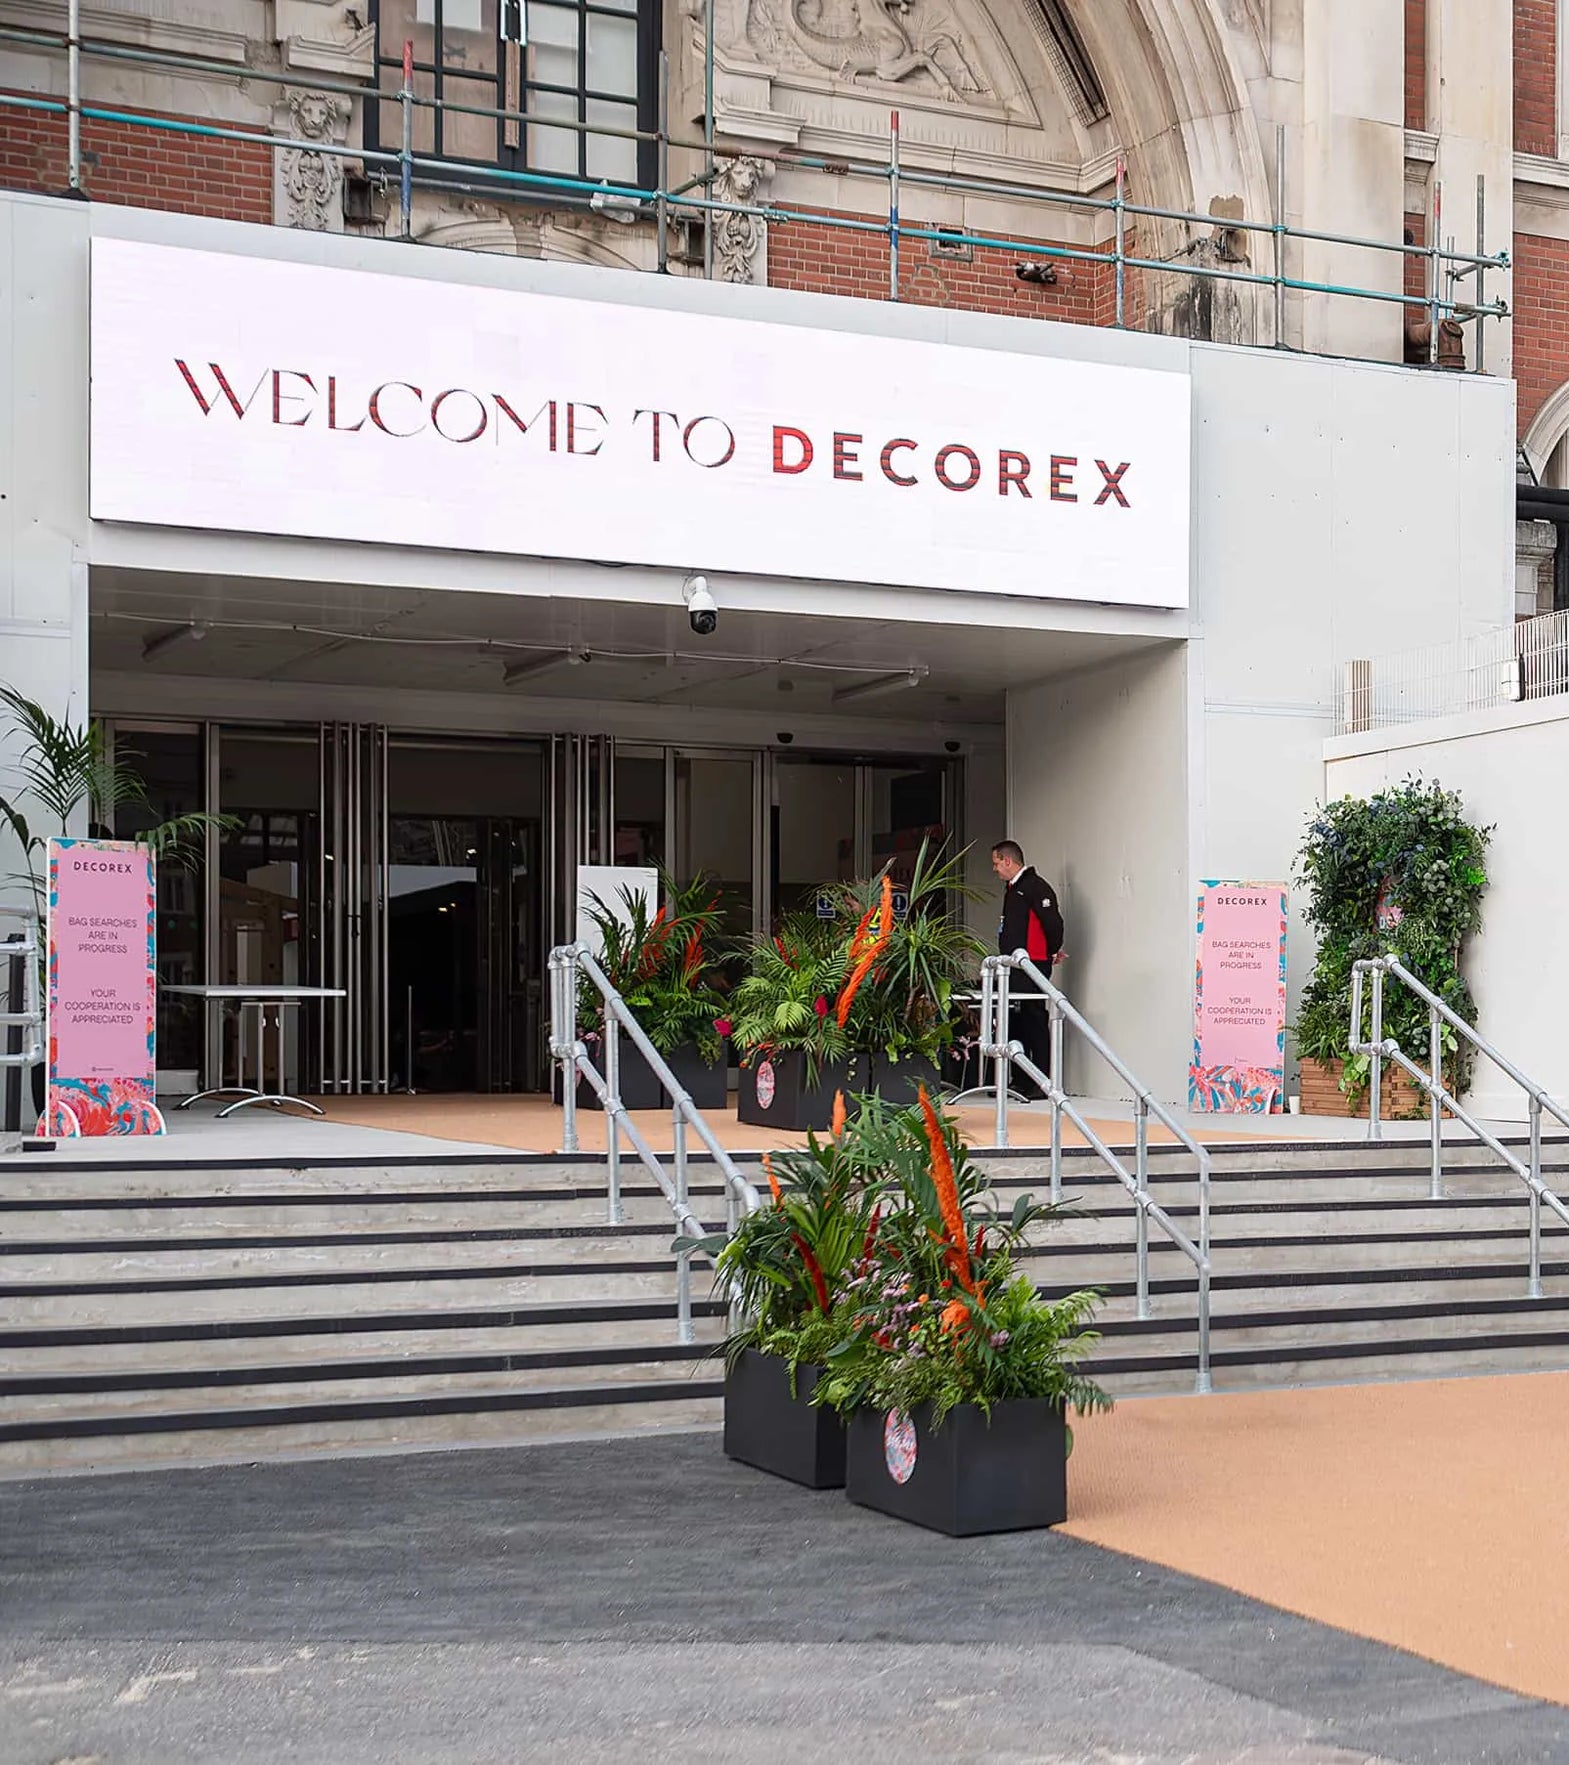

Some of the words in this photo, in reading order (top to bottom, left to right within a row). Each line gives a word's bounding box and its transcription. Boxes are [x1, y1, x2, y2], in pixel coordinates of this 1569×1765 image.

[174, 358, 609, 456] WELCOME
[632, 409, 736, 468] TO
[772, 425, 1132, 508] DECOREX
[73, 861, 132, 874] DECOREX
[1217, 897, 1267, 906] DECOREX
[68, 917, 88, 927] BAG
[90, 917, 137, 929] SEARCHES
[88, 931, 107, 940] ARE
[109, 932, 118, 941] IN
[78, 944, 128, 954] PROGRESS
[1212, 940, 1228, 949] BAG
[1229, 941, 1271, 950] SEARCHES
[1220, 962, 1262, 970] PROGRESS
[90, 989, 116, 998] YOUR
[65, 1001, 131, 1011] COOPERATION
[133, 1002, 141, 1011] IS
[1207, 1006, 1263, 1015] COOPERATION
[1265, 1007, 1272, 1015] IS
[72, 1014, 133, 1024] APPRECIATED
[1213, 1017, 1266, 1025] APPRECIATED
